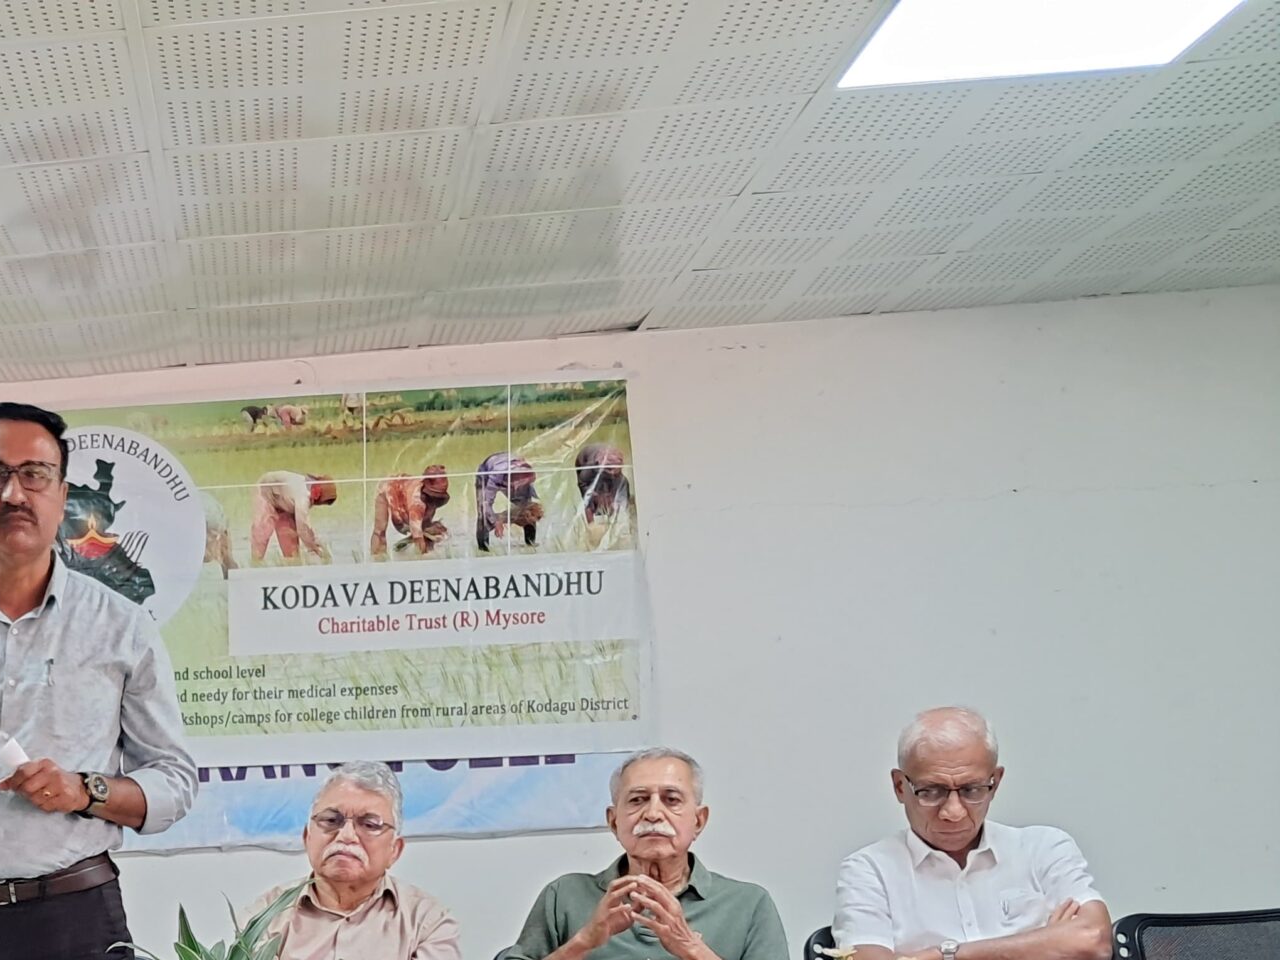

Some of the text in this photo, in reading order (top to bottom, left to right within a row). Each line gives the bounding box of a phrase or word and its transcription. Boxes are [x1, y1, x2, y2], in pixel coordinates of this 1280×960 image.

[67, 433, 190, 502] DEENABANDHU
[261, 570, 605, 610] KODAVA DEENABANDHU
[318, 608, 546, 635] Charitable Trust (R) Mysore
[174, 664, 266, 681] nd school level
[191, 688, 228, 705] needy
[232, 687, 251, 702] for
[253, 685, 285, 700] their
[288, 683, 336, 699] medical
[340, 683, 398, 701] expenses
[181, 696, 630, 728] kshops/camps for college children from rural areas of Kodagu District
